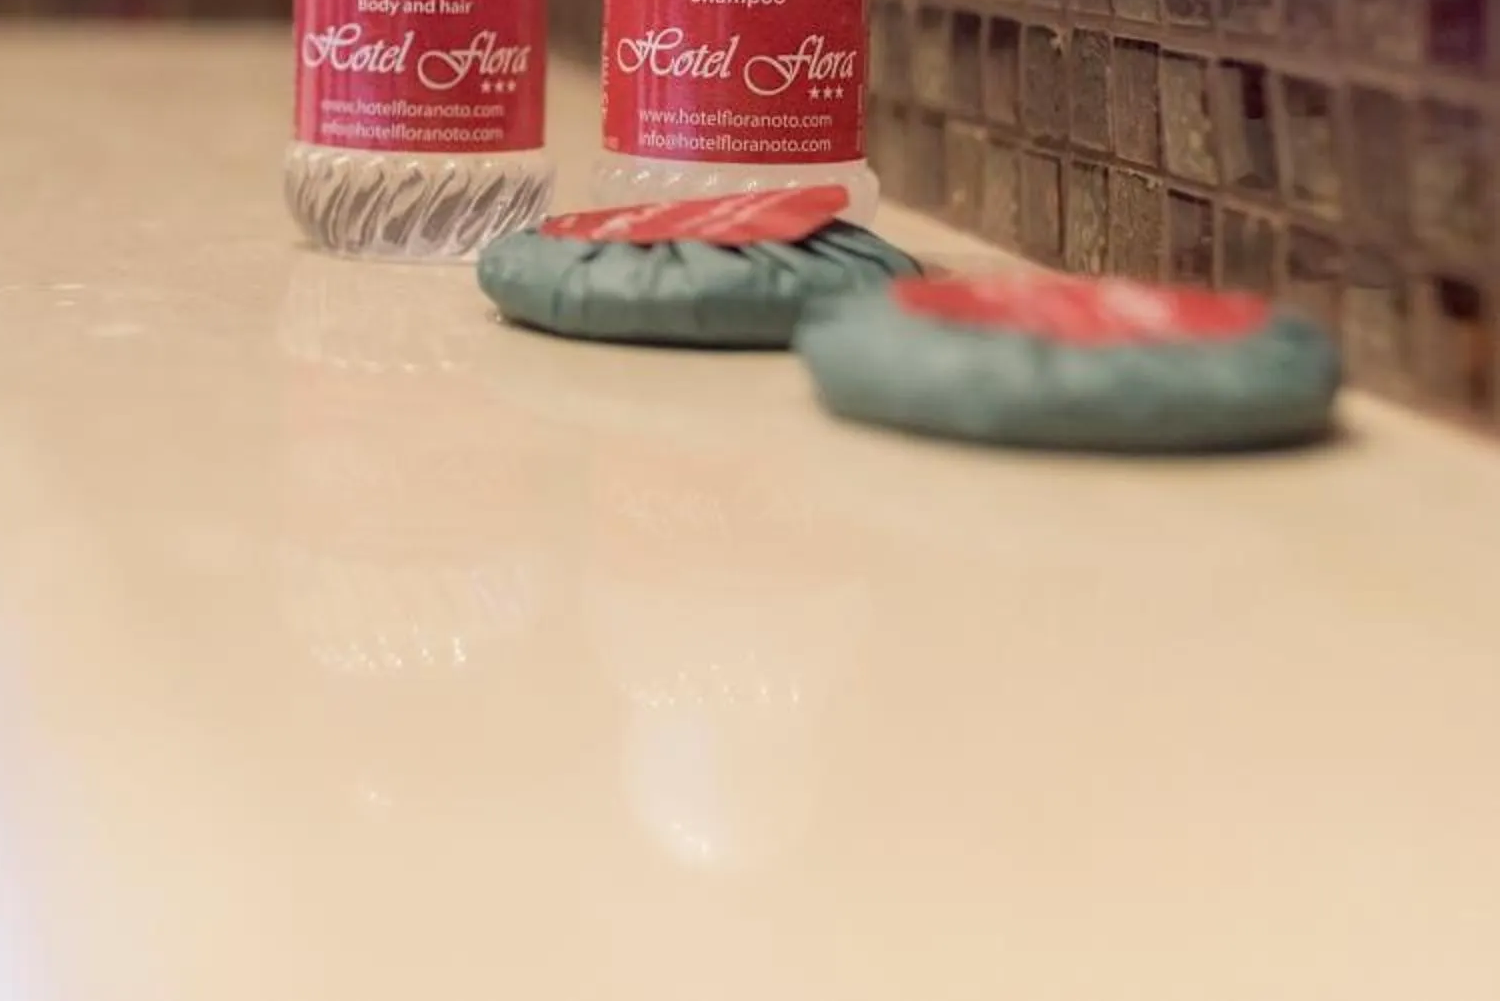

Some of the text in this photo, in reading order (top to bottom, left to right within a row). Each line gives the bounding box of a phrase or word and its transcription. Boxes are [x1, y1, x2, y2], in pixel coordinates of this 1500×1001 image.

[302, 22, 531, 90] Hotel Flora
[617, 27, 741, 79] Hotel
[743, 34, 857, 96] Flora
[321, 121, 504, 141] hotelfloranoto.com
[638, 108, 833, 129] www.hotelfloranoto.com
